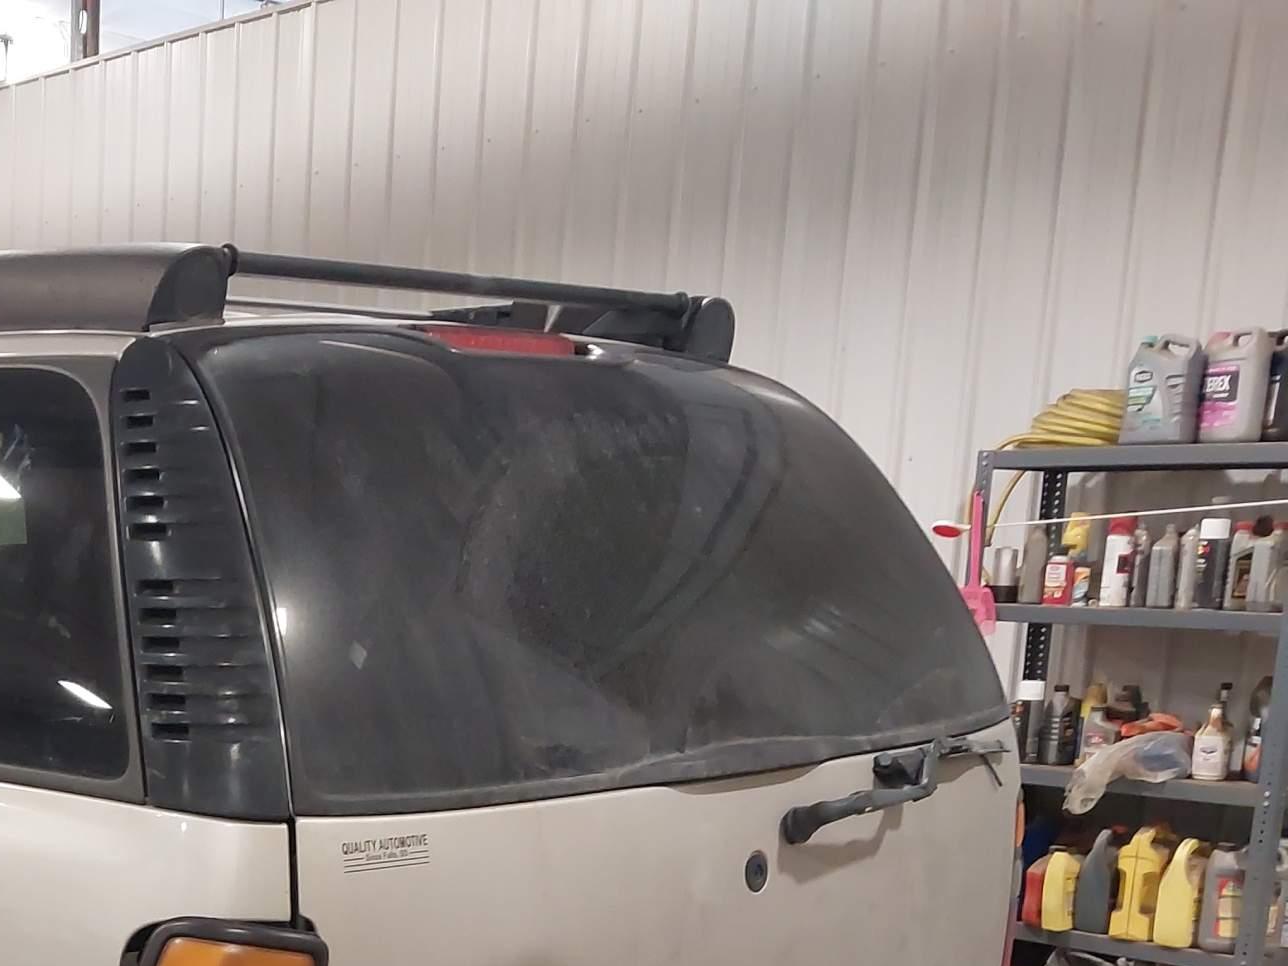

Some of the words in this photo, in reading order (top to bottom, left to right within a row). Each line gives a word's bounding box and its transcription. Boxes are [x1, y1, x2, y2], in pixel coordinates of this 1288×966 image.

[1203, 374, 1232, 393] EREX
[342, 840, 377, 855] QUALITY
[378, 834, 428, 850] AUTOMOTIVE
